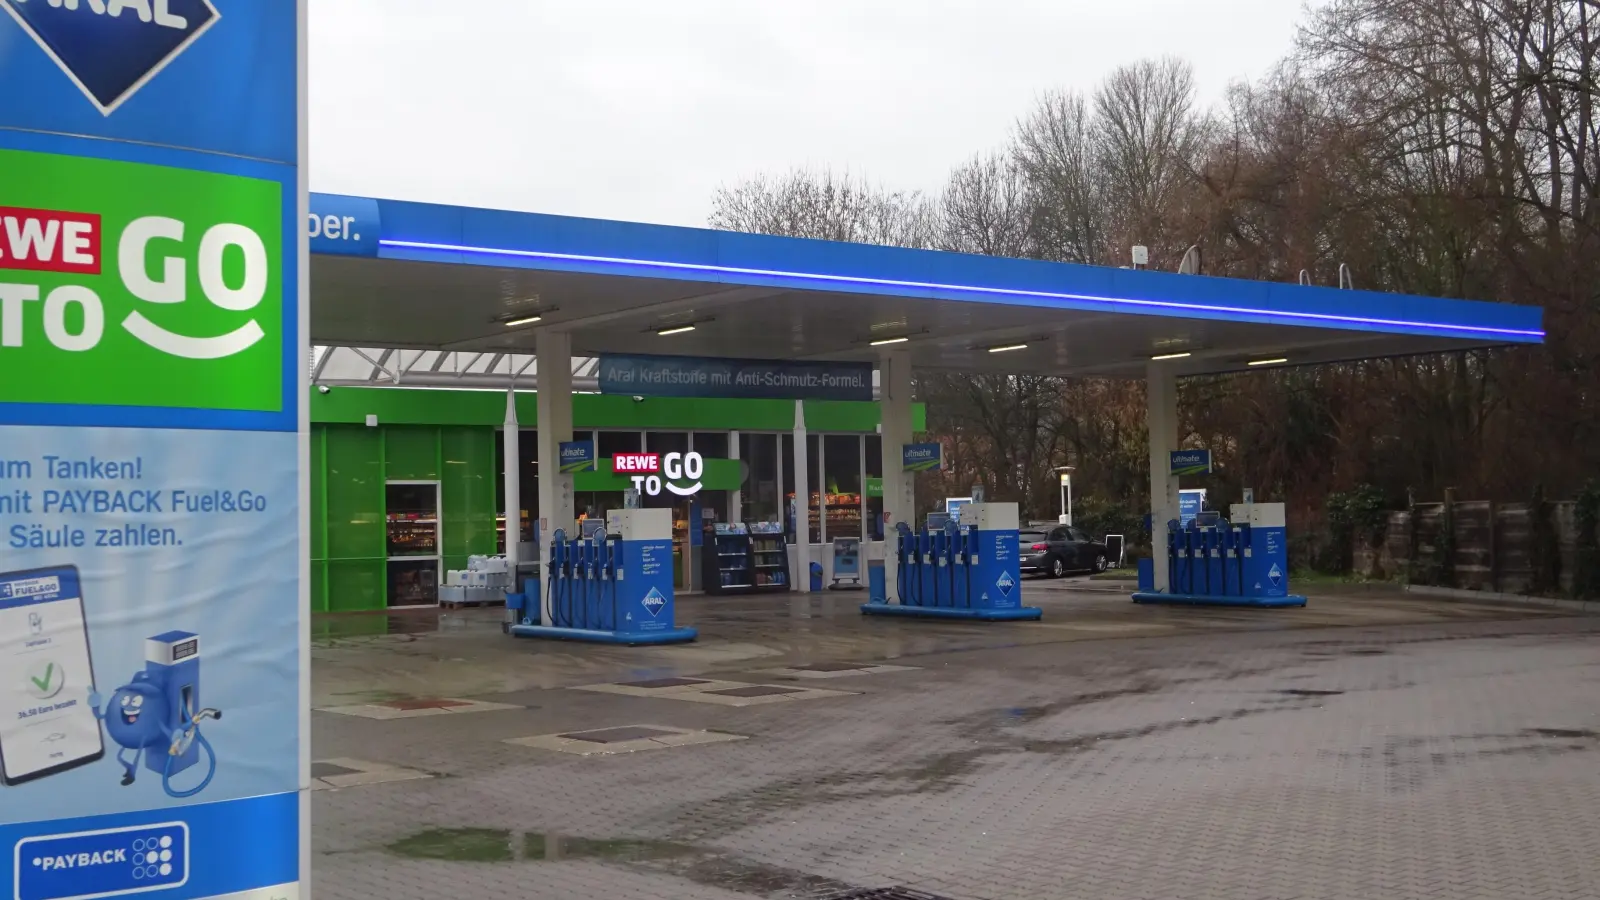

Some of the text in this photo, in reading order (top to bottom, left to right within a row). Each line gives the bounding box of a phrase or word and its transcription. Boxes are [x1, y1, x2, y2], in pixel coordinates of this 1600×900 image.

[0, 216, 95, 265] WE
[118, 216, 268, 311] GO
[0, 283, 105, 352] TO
[606, 366, 866, 388] Aral Kraftstoffe mit Anti-Schmutz-Formel.
[616, 455, 658, 470] REWE
[904, 448, 932, 458] ultimate
[42, 455, 142, 479] Tanken!
[664, 451, 704, 480] GO
[631, 475, 662, 496] TO
[43, 490, 162, 513] PAYBACK
[171, 489, 267, 513] Fuel&Go
[9, 523, 183, 548] Säule zahlen.
[15, 583, 57, 596] FUEL&GO
[998, 579, 1013, 587] ARAL
[644, 597, 664, 606] ARAL
[42, 848, 127, 871] PAYBACK
